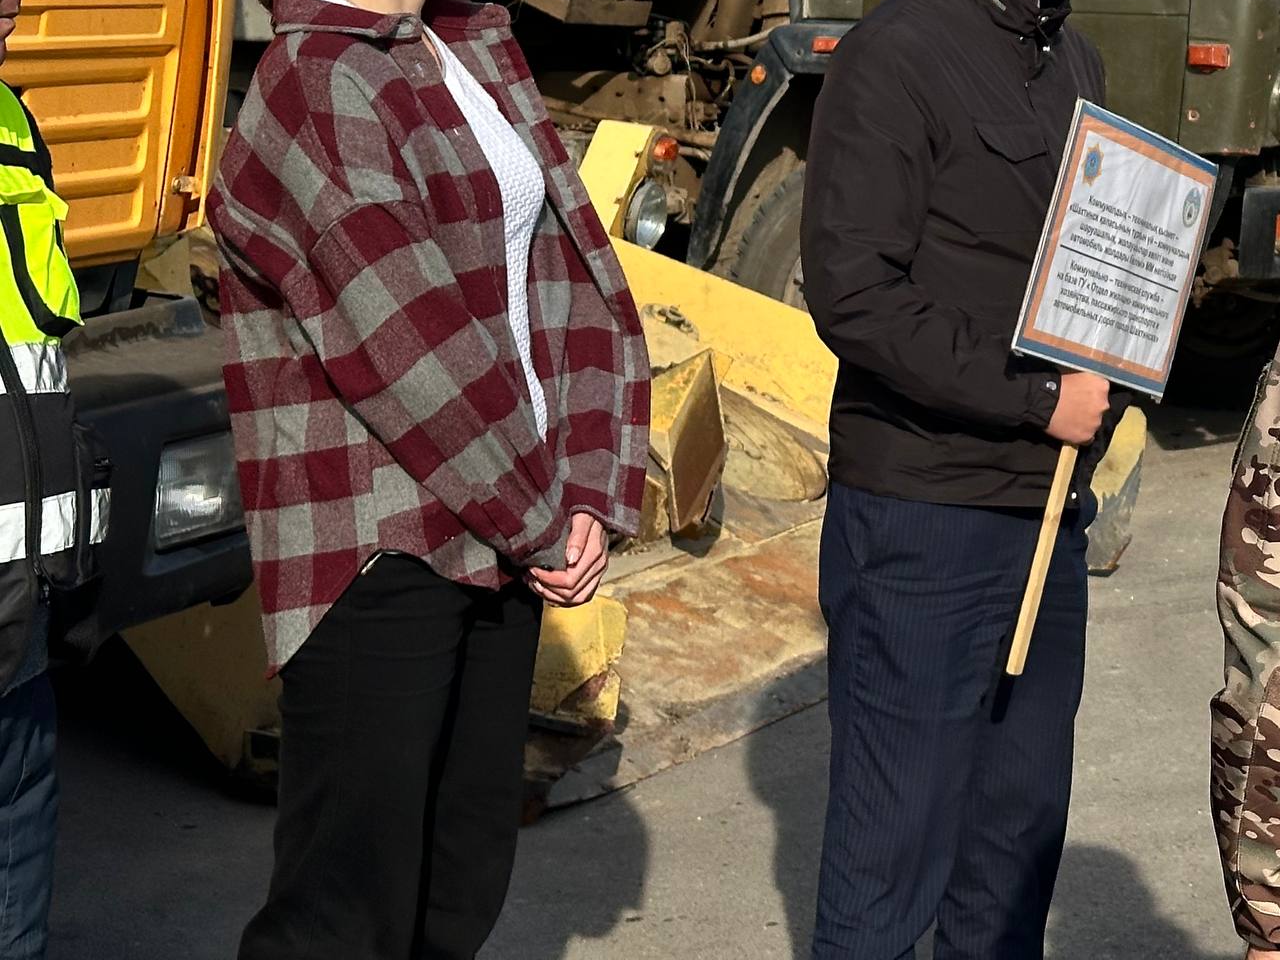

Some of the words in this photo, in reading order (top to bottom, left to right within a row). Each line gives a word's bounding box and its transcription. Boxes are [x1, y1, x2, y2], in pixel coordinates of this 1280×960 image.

[1069, 259, 1109, 284] Коммунально
[1064, 272, 1078, 285] базе
[1090, 281, 1109, 297] Отдел
